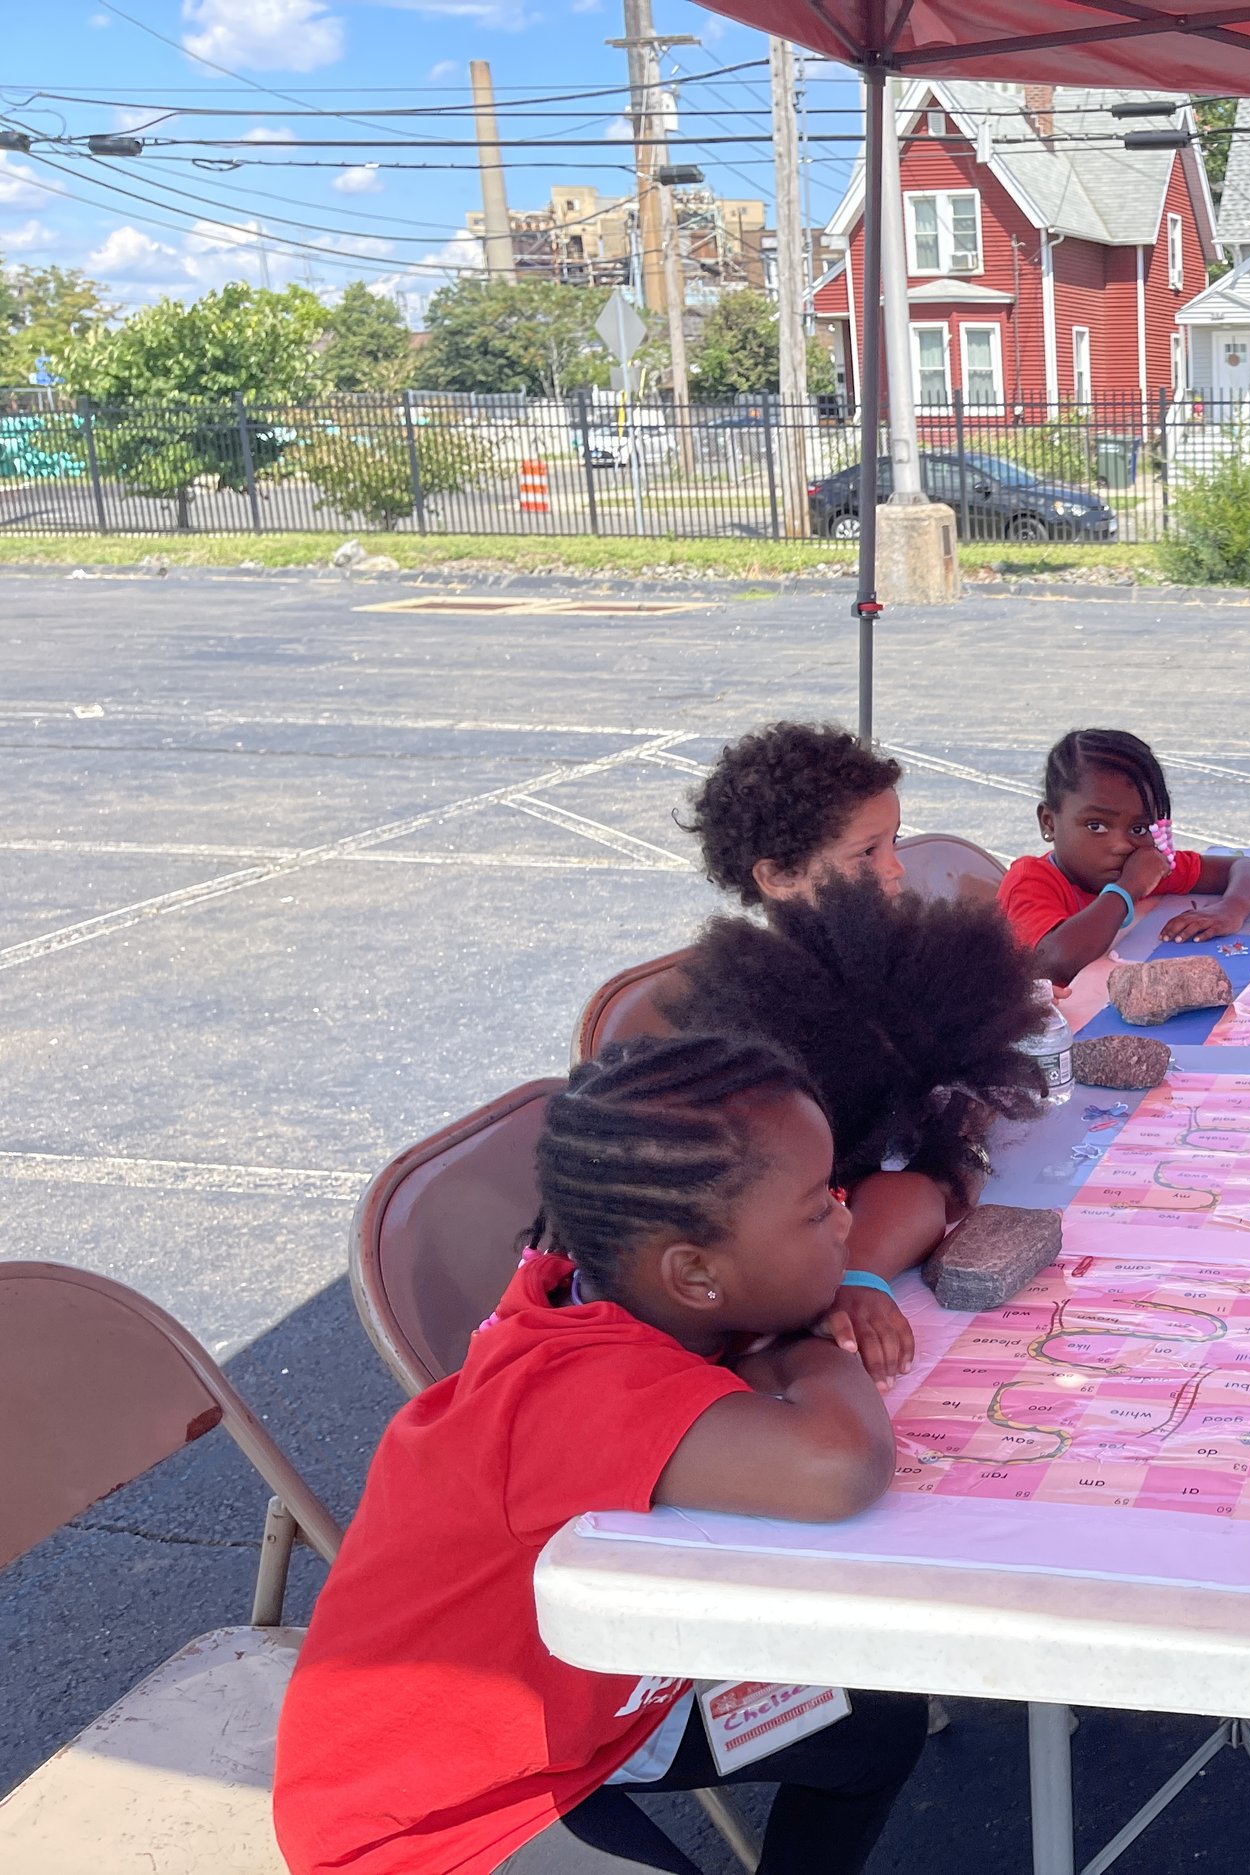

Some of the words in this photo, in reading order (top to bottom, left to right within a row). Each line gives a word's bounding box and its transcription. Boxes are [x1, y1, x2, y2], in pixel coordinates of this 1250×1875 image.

[1001, 1310, 1031, 1319] well
[971, 1337, 1022, 1348] please
[1067, 1342, 1092, 1352] like
[1225, 1381, 1250, 1392] but
[942, 1400, 961, 1409] he
[1110, 1409, 1152, 1420] white
[1202, 1415, 1244, 1424] good
[905, 1431, 947, 1441] there
[1000, 1435, 1035, 1445] saw
[1197, 1448, 1218, 1458] do
[980, 1471, 1009, 1480] ran
[918, 1483, 934, 1491] 57
[1078, 1478, 1106, 1488] am
[1181, 1487, 1200, 1496] at
[1114, 1498, 1130, 1506] 59
[1216, 1505, 1233, 1514] 60
